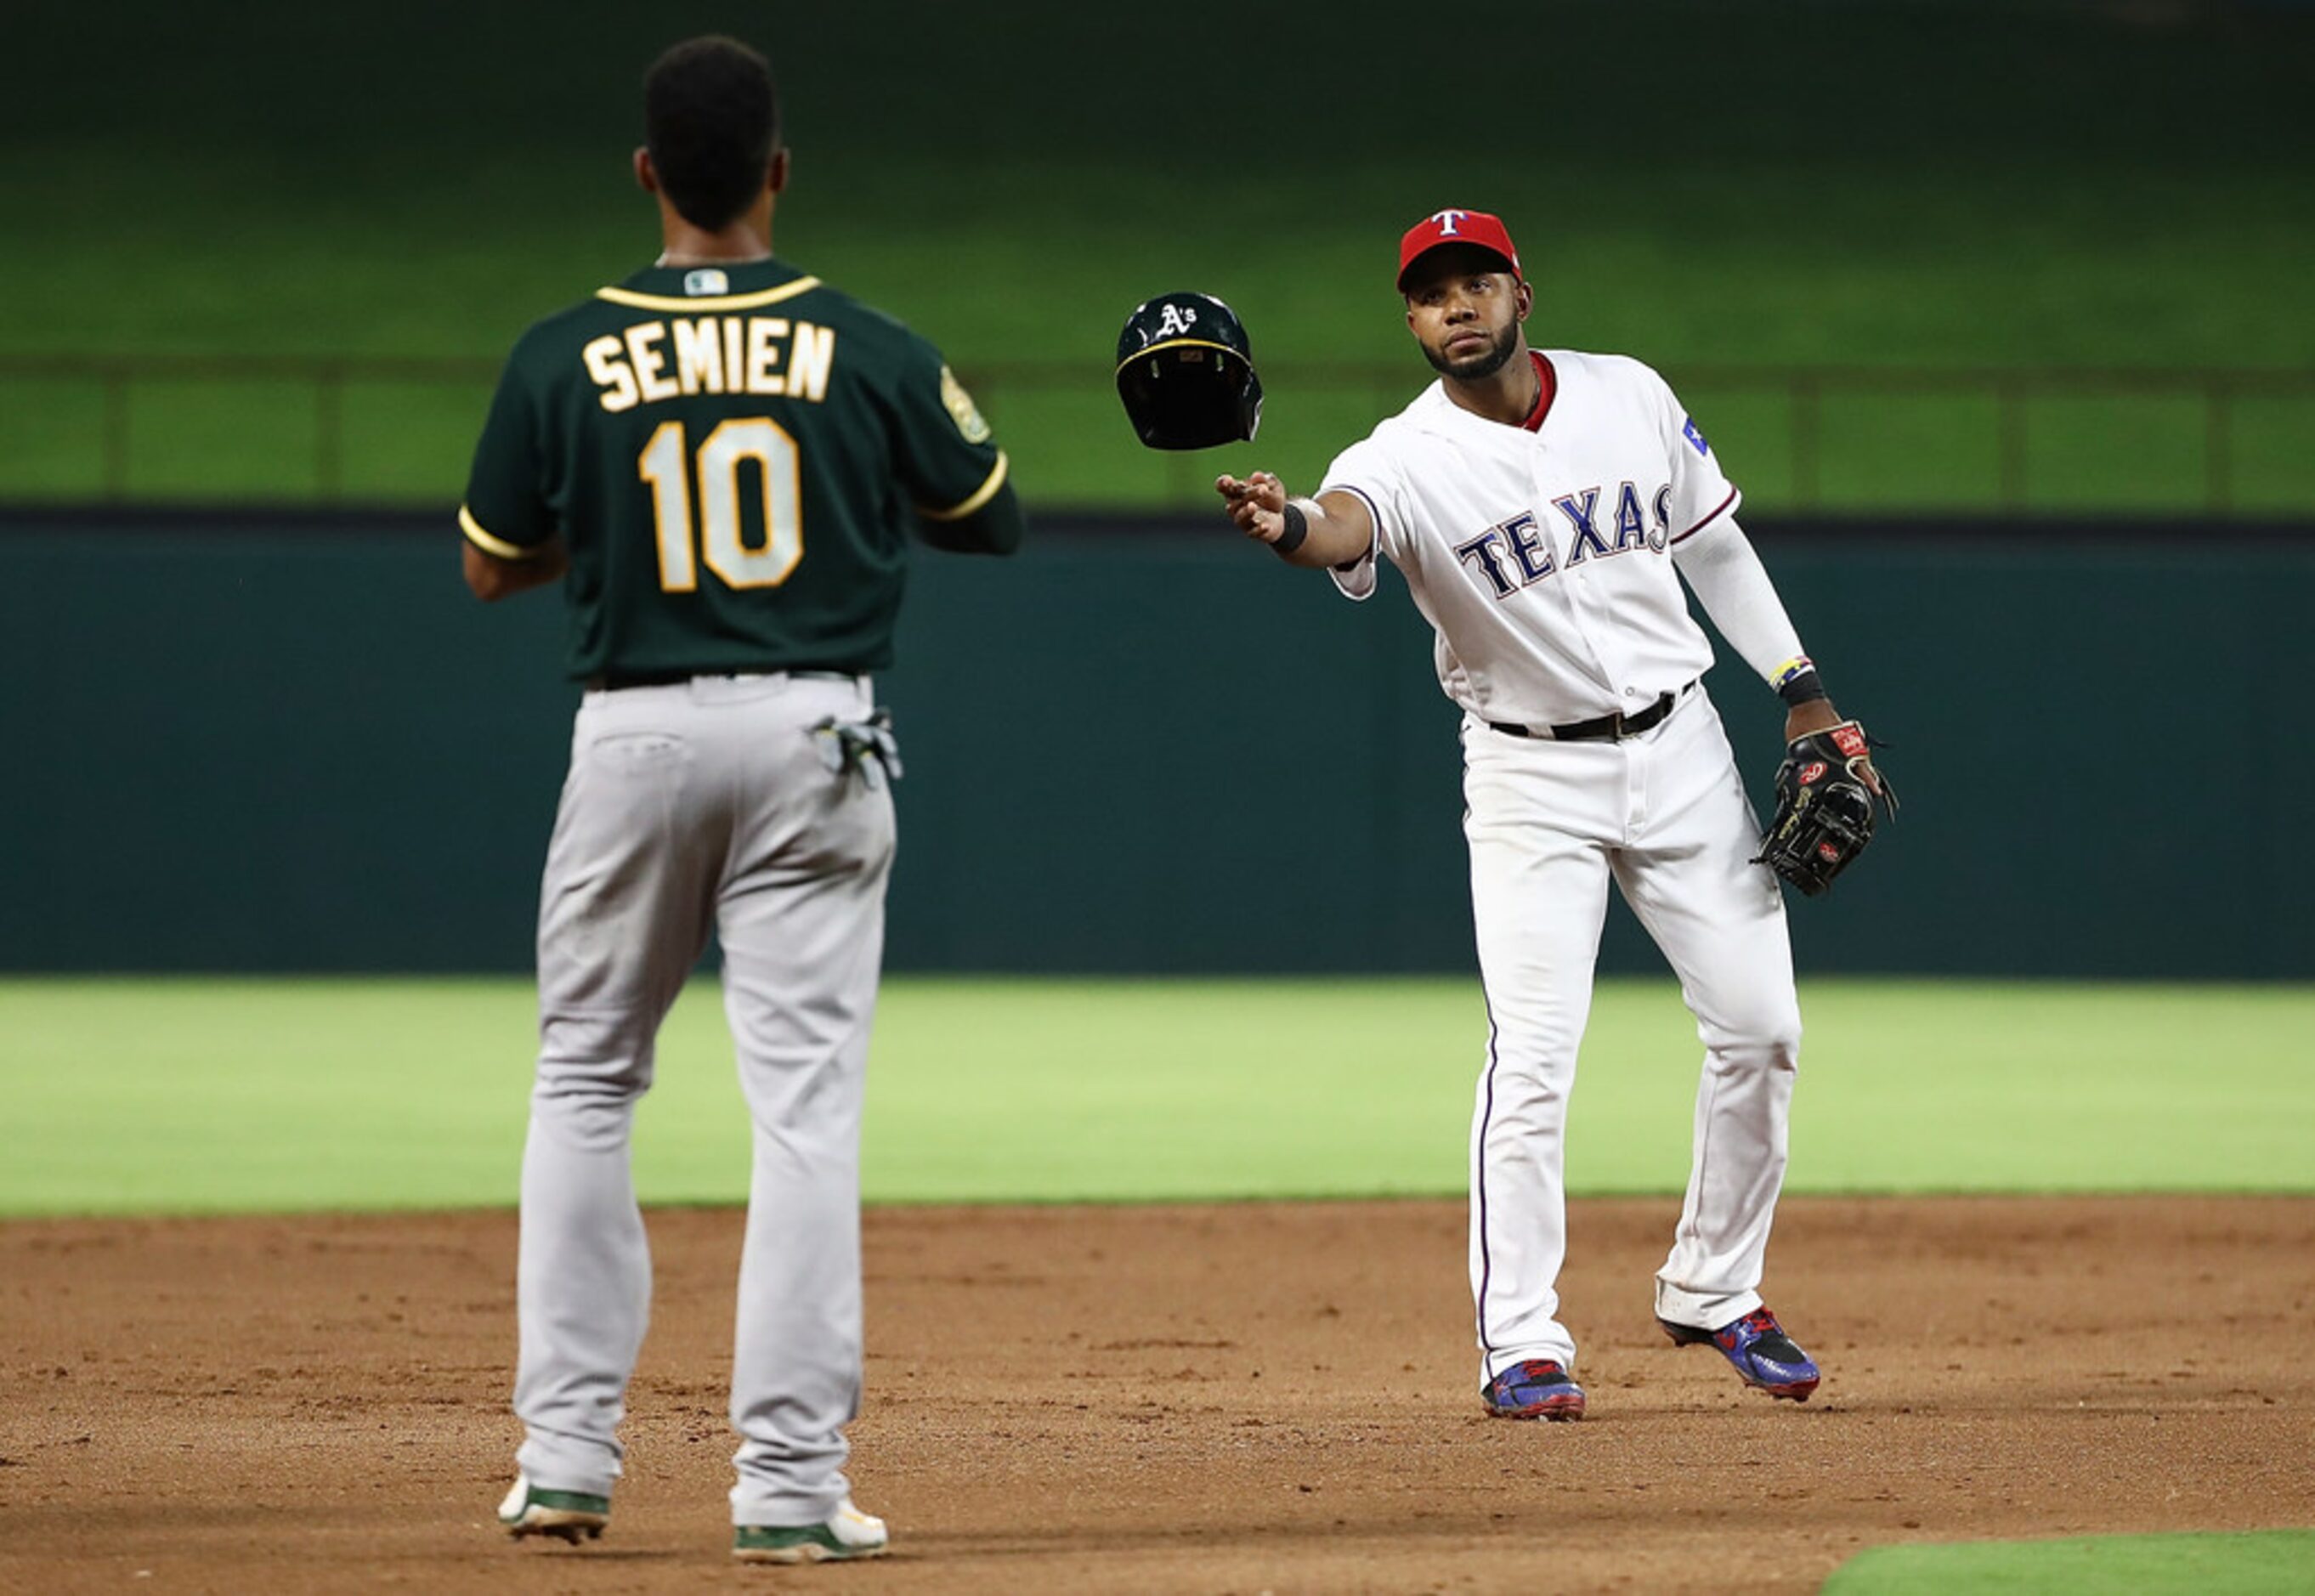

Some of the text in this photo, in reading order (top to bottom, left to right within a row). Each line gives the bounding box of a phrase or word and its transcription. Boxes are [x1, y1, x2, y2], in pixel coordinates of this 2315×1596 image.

[1431, 209, 1469, 236] T
[582, 317, 835, 412] SEMIEN
[1155, 303, 1197, 339] A's
[638, 416, 804, 593] 10
[1452, 481, 1672, 600] TEXAS
